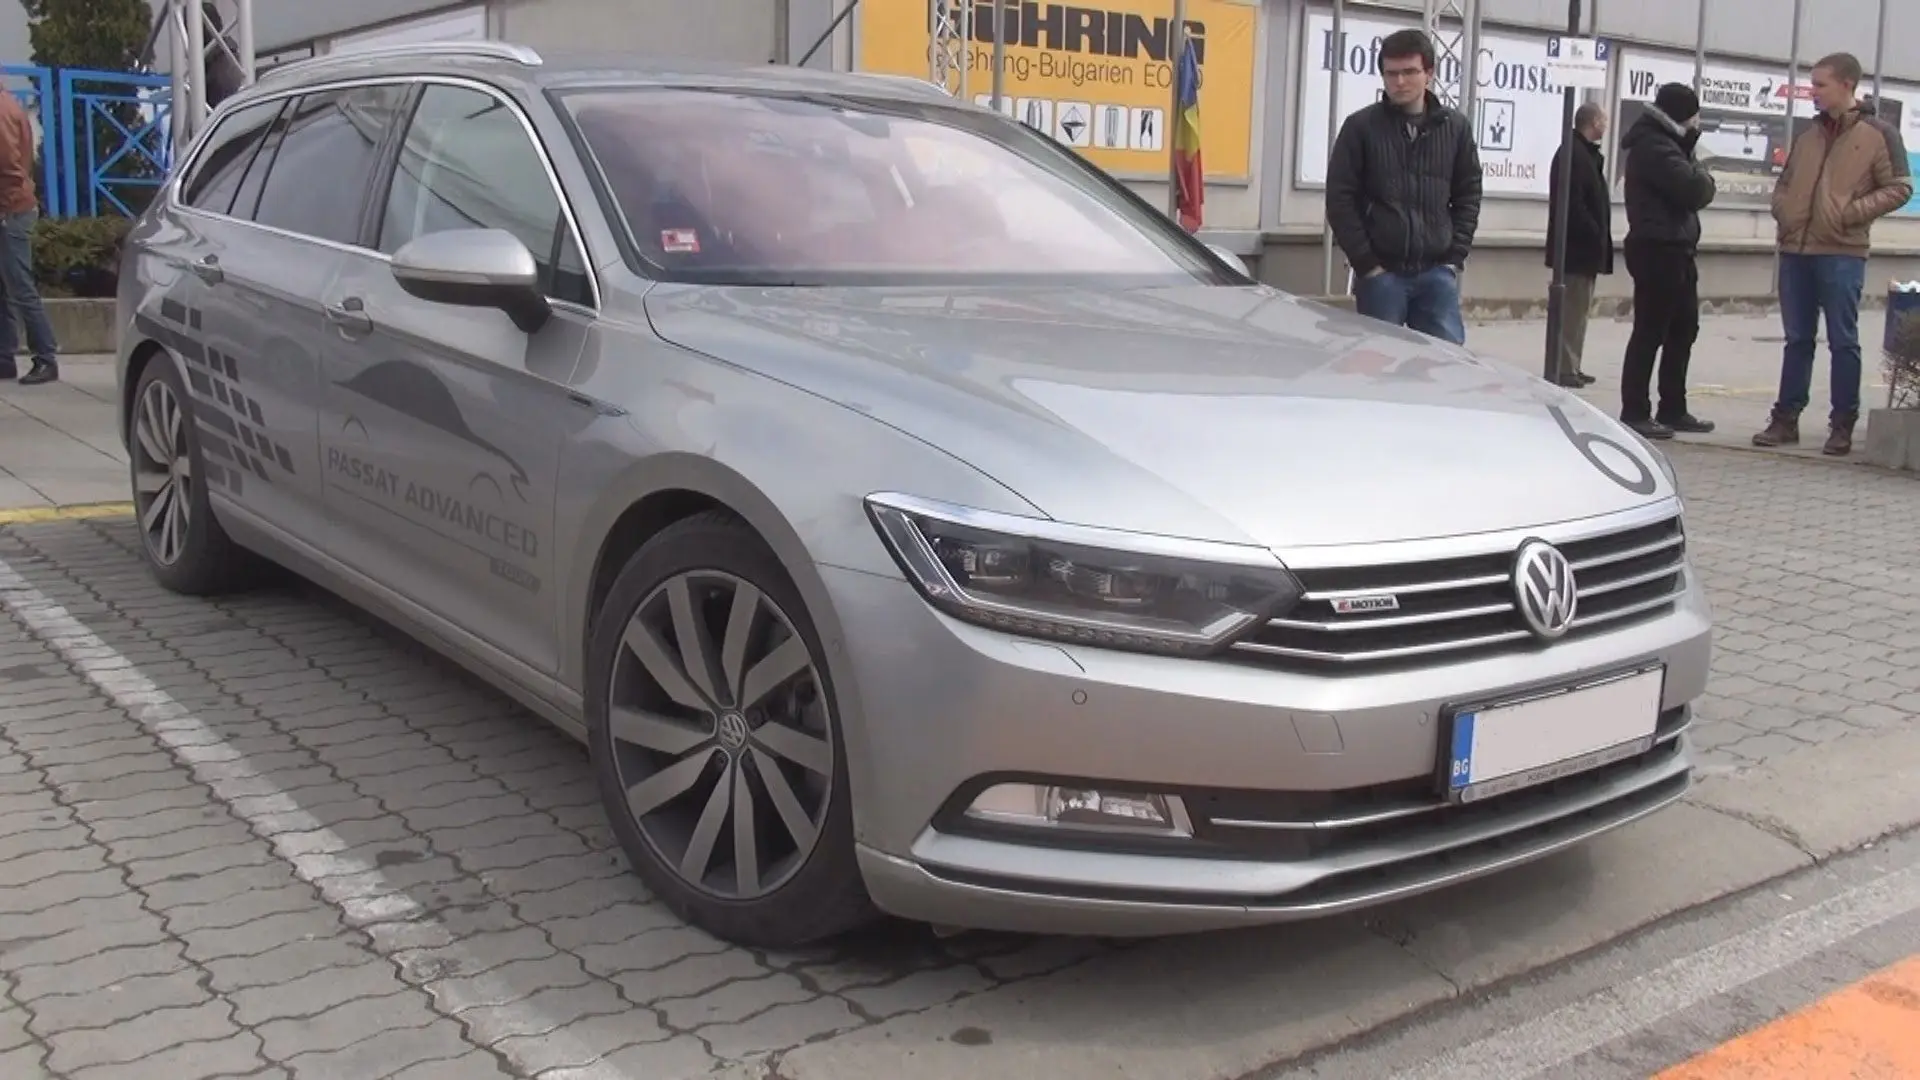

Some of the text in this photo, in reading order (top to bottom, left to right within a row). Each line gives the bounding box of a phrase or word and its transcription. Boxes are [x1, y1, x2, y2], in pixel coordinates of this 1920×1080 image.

[1630, 70, 1654, 95] VIP
[1546, 403, 1657, 495] 6
[328, 447, 539, 558] PASSAT ADVANCED
[1452, 758, 1469, 776] BG
